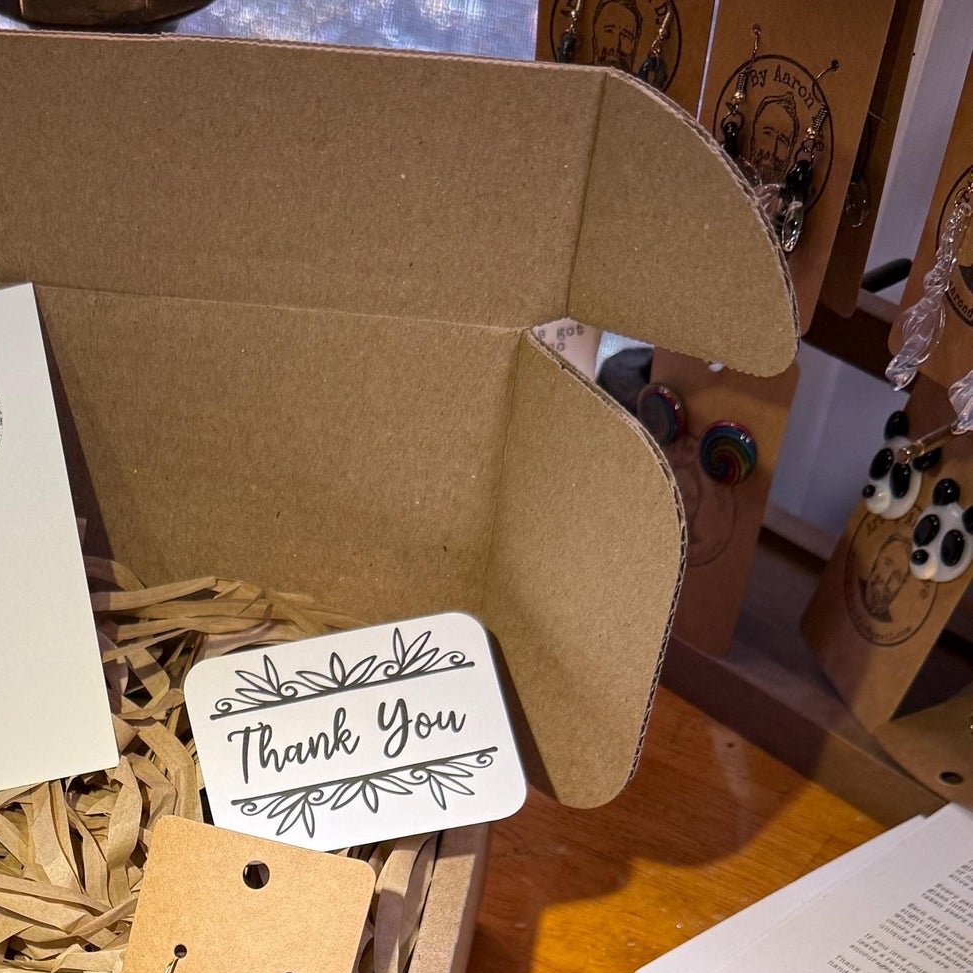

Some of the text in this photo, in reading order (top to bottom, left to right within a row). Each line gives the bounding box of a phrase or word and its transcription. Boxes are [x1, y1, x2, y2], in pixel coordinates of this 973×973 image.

[748, 64, 816, 110] By Aaron
[227, 698, 466, 784] Thank You
